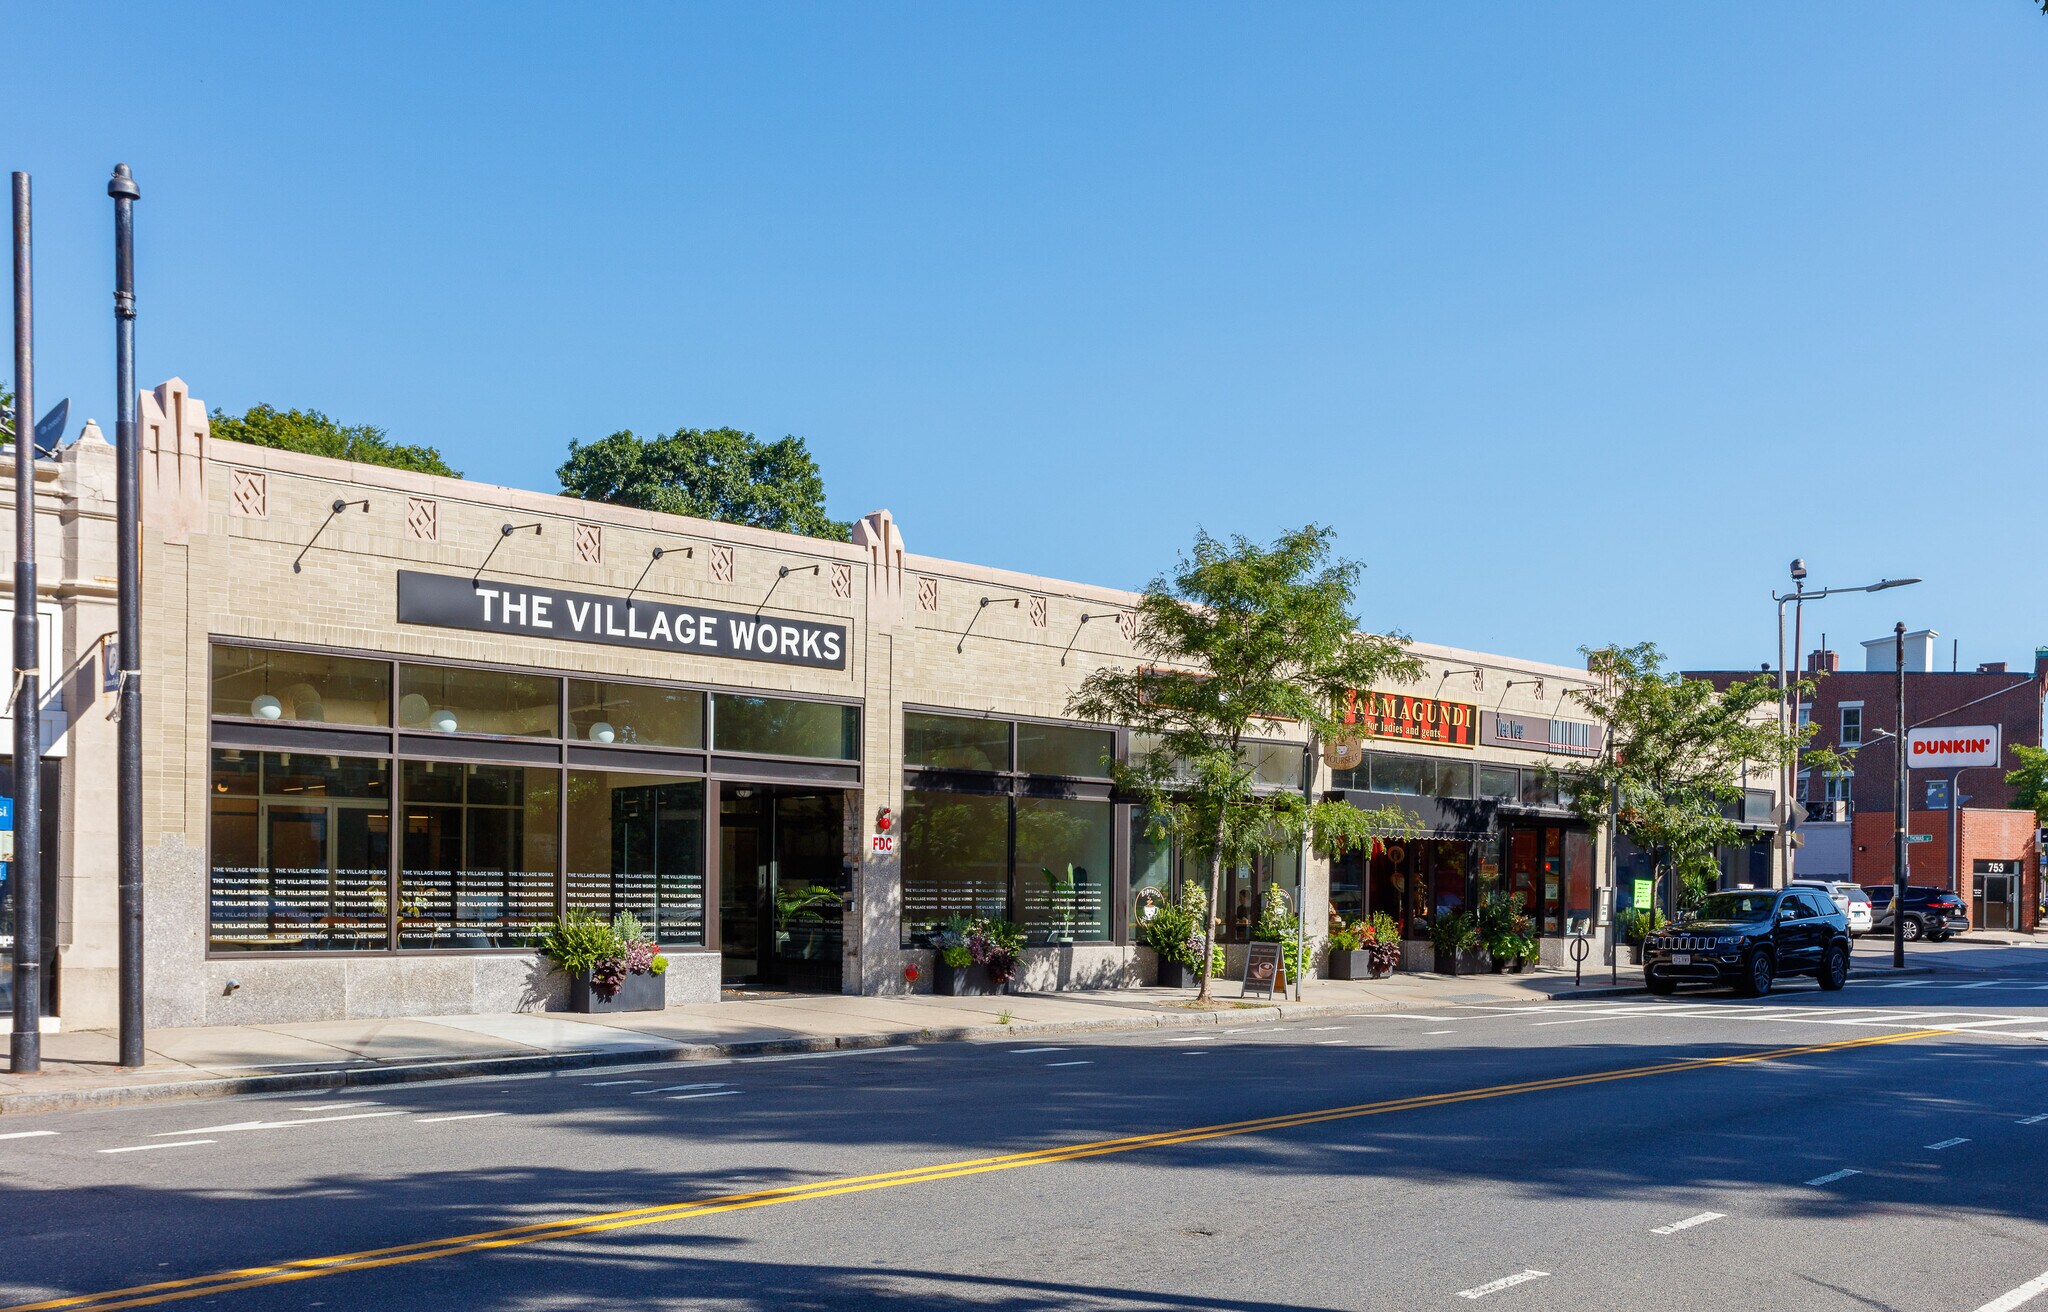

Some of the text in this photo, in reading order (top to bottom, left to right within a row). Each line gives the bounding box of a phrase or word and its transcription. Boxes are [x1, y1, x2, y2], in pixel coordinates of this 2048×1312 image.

[476, 588, 841, 661] THE VILLAGE WORKS
[1342, 694, 1471, 727] SALMAGUNDI
[1367, 720, 1378, 731] for
[1381, 721, 1403, 734] ladies
[1405, 724, 1419, 736] and
[1497, 718, 1524, 739] Vee Vee
[1913, 738, 1990, 755] DUNKIN'
[1326, 753, 1359, 764] YOURSELF
[873, 837, 892, 851] FDC
[1988, 863, 2004, 872] 753
